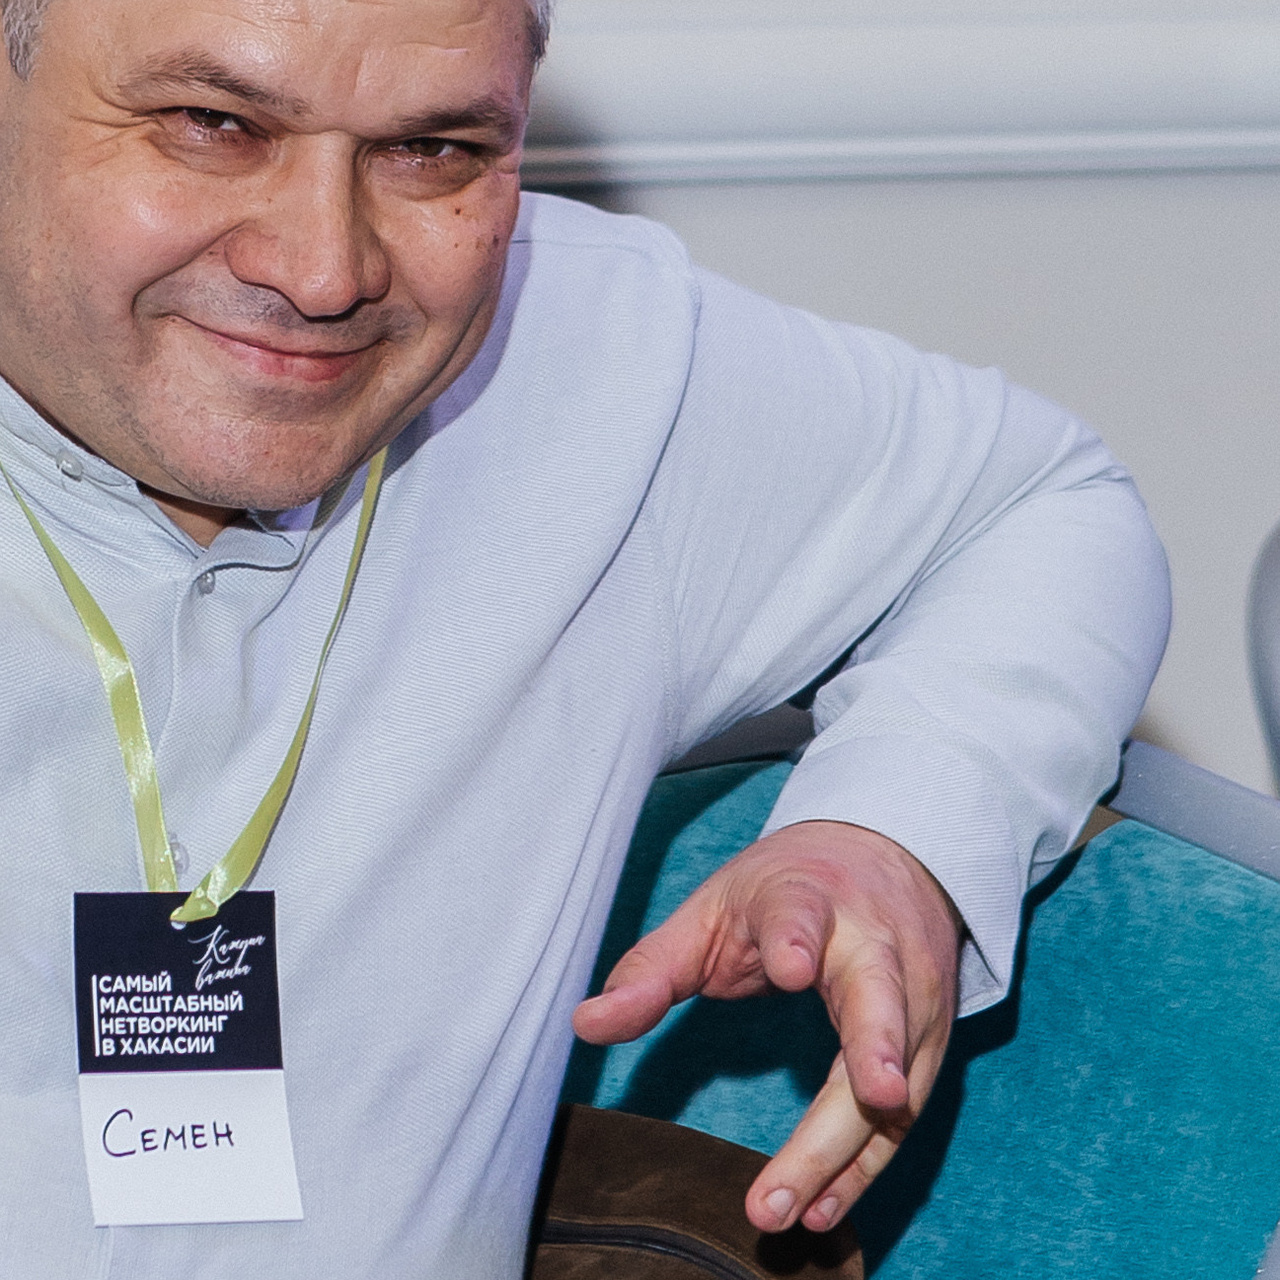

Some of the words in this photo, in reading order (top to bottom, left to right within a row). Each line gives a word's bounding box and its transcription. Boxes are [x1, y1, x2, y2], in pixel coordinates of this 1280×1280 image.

[98, 970, 172, 993] САМЫЙ
[99, 990, 244, 1014] МАСШТАБНЫЙ
[101, 1015, 228, 1035] НЕТВОРКИНГ
[102, 1038, 116, 1056] В
[120, 1036, 215, 1055] ХАКАСИИ
